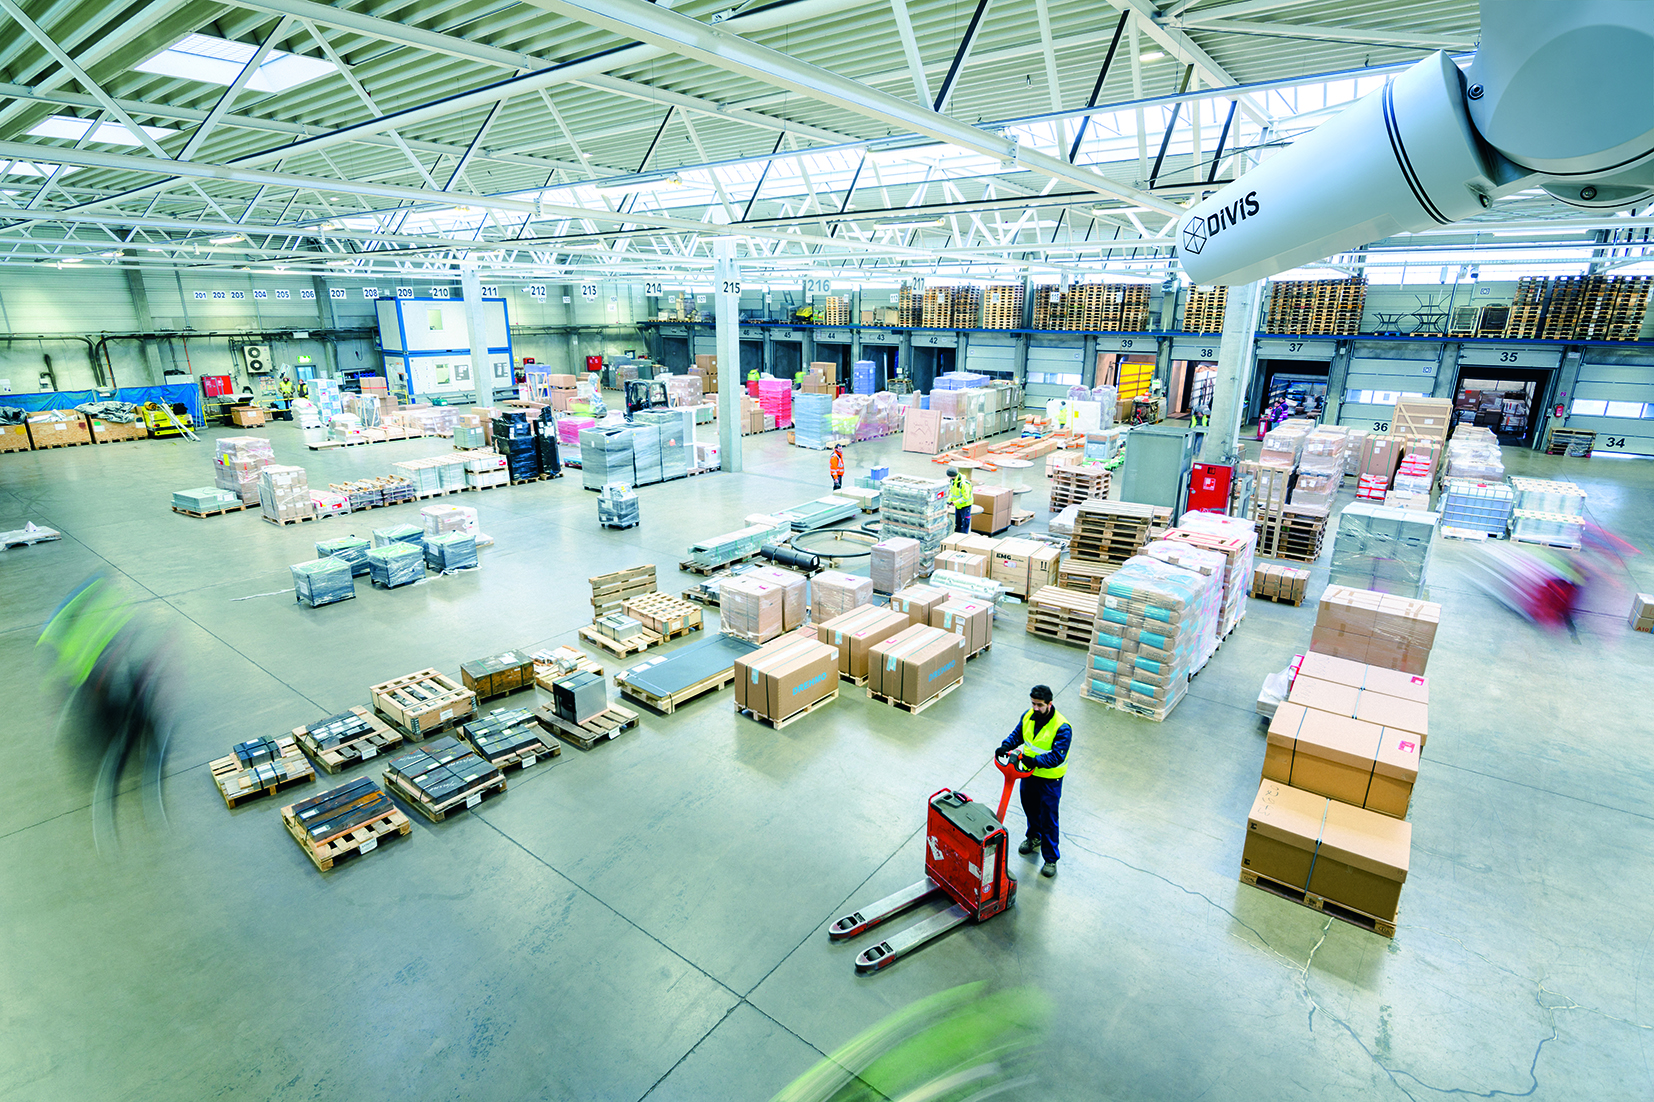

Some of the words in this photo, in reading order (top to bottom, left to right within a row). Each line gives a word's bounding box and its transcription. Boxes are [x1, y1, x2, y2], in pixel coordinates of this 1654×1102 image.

[646, 282, 662, 294] 214
[723, 281, 740, 294] 215
[807, 279, 830, 292] 216
[912, 277, 925, 291] 217
[212, 291, 225, 299] 202
[230, 291, 244, 299] 203
[254, 290, 267, 298] 204
[276, 290, 290, 298] 205
[301, 290, 315, 298] 206
[331, 289, 345, 298] 207
[364, 289, 377, 297] 208
[397, 288, 413, 297] 209
[433, 287, 448, 297] 210
[481, 286, 497, 296] 211
[531, 286, 546, 296] 212
[582, 285, 597, 296] 213
[784, 331, 792, 339] 45
[827, 332, 836, 340] 44
[876, 333, 885, 341] 43
[929, 336, 938, 345] 42
[1121, 339, 1133, 348] 39
[1289, 342, 1303, 352] 37
[1200, 348, 1213, 358] 38
[1500, 351, 1519, 362] 35
[1372, 421, 1389, 432] 36
[1606, 437, 1625, 448] 34
[928, 659, 956, 683] DREHMO
[792, 671, 828, 696] DREHMO
